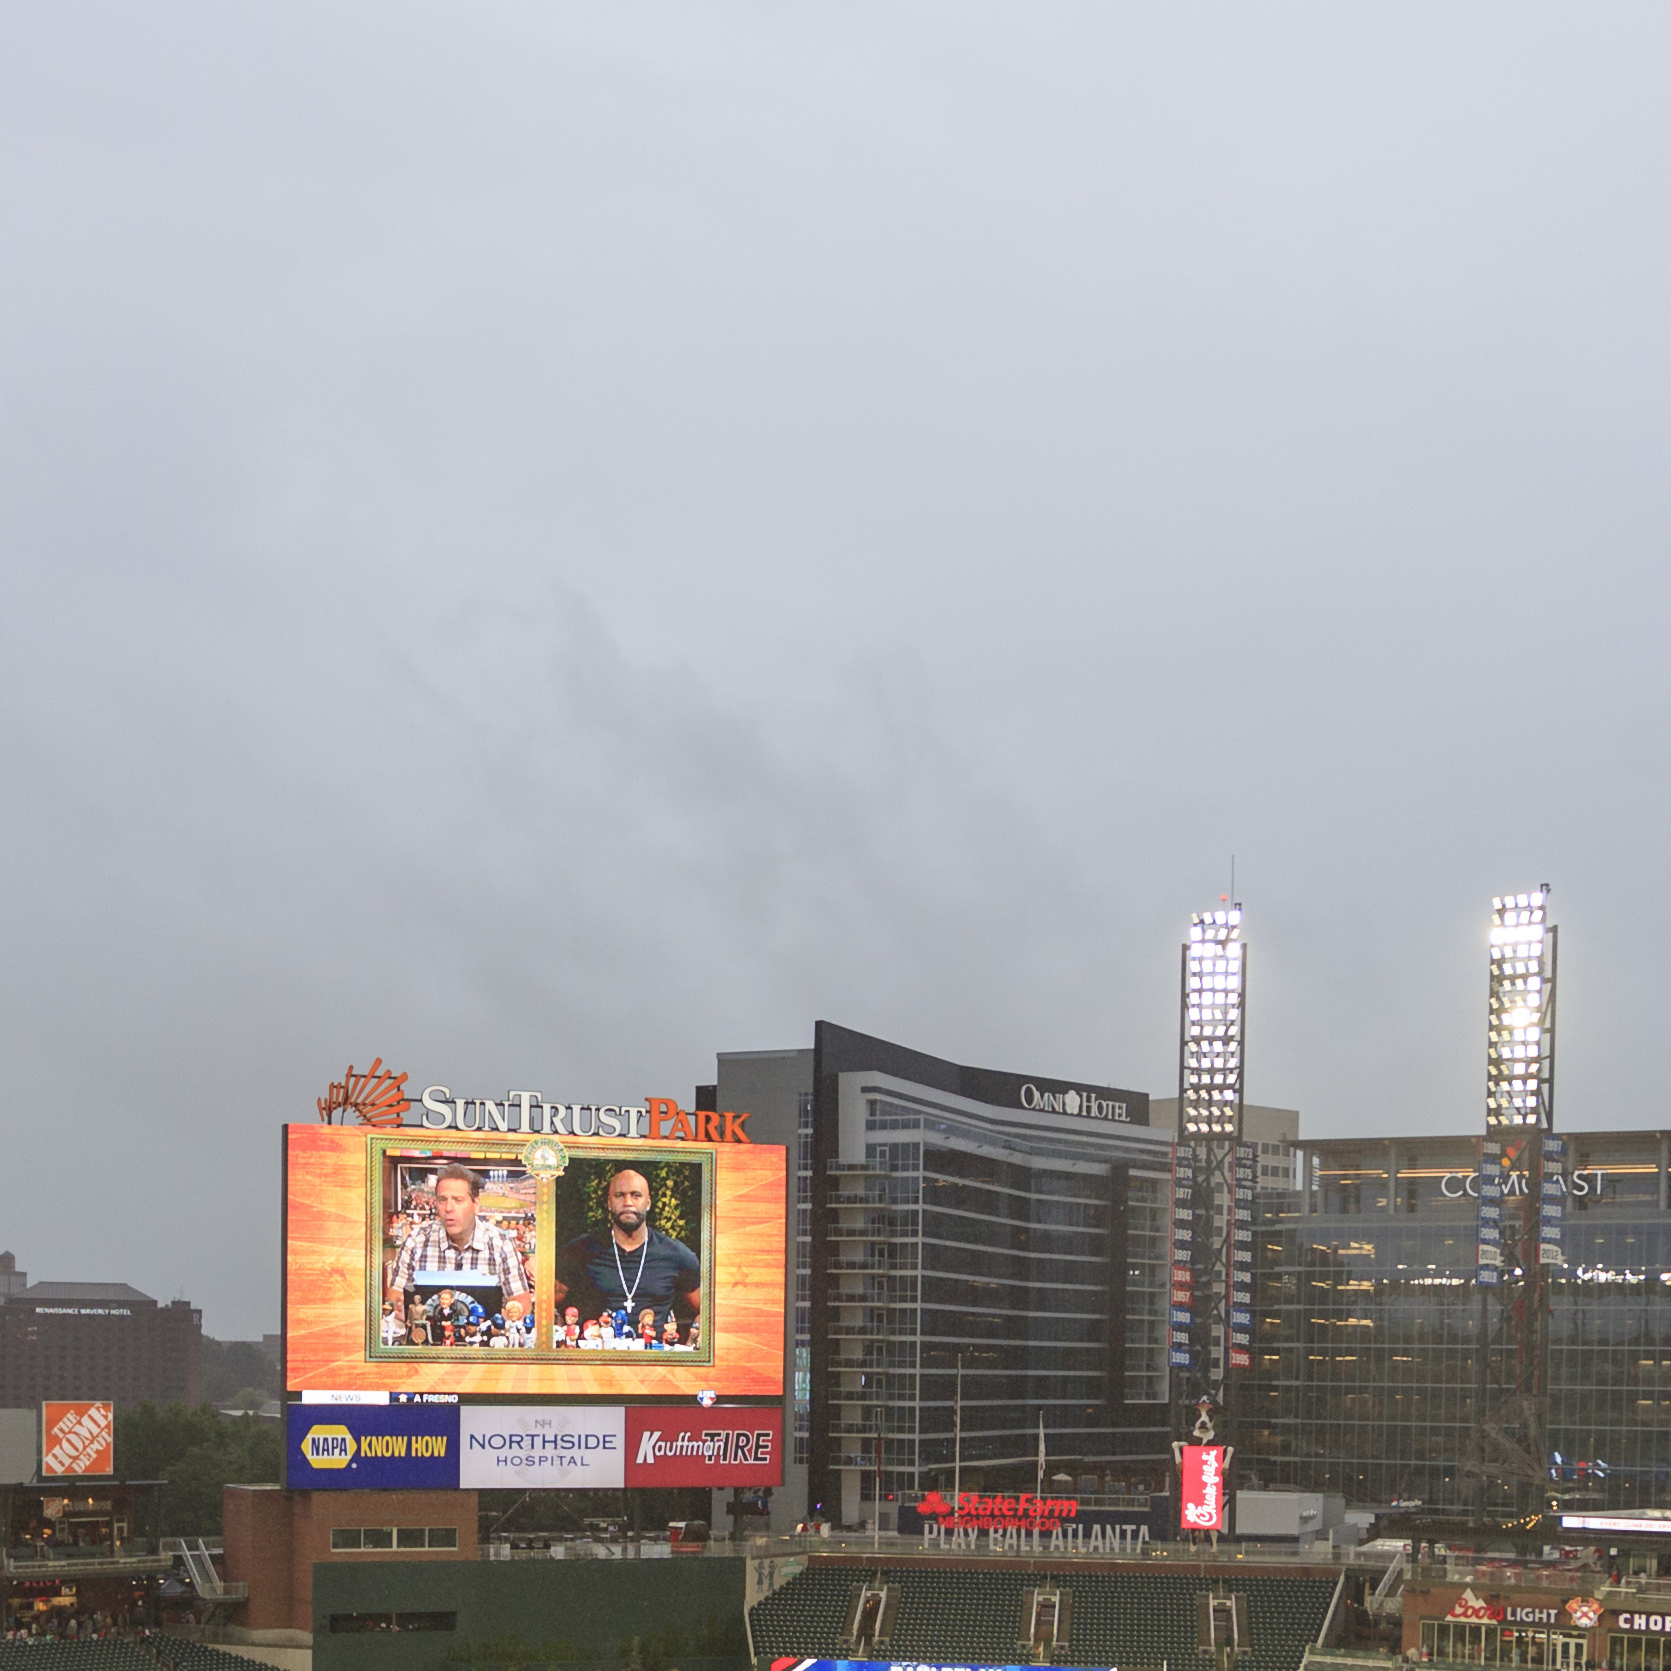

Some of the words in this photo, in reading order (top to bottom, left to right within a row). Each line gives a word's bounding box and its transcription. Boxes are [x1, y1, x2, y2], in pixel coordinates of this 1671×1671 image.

[1020, 1083, 1064, 1113] OMNI
[1080, 1091, 1130, 1122] HOTEL
[110, 1308, 132, 1316] HOTEL
[330, 1393, 361, 1402] NEWS
[423, 1394, 459, 1404] FRESNO
[51, 1409, 81, 1440] THE
[43, 1401, 113, 1475] HOME
[310, 1436, 348, 1457] NAPA
[360, 1435, 407, 1457] KNOW
[411, 1435, 447, 1457] HOW
[469, 1433, 618, 1450] NORTHSIDE
[635, 1430, 725, 1464] Kauffman
[701, 1430, 773, 1464] TIRE
[70, 1428, 113, 1475] DEPOT
[495, 1455, 590, 1467] HOSPITAL
[937, 1515, 1061, 1531] NEIGHBORHOOD
[923, 1520, 978, 1550] PLAY
[988, 1521, 1044, 1551] BALL
[1049, 1523, 1150, 1554] ATLANTA
[1448, 1597, 1505, 1622] Coors
[1506, 1606, 1559, 1624] LIGHT
